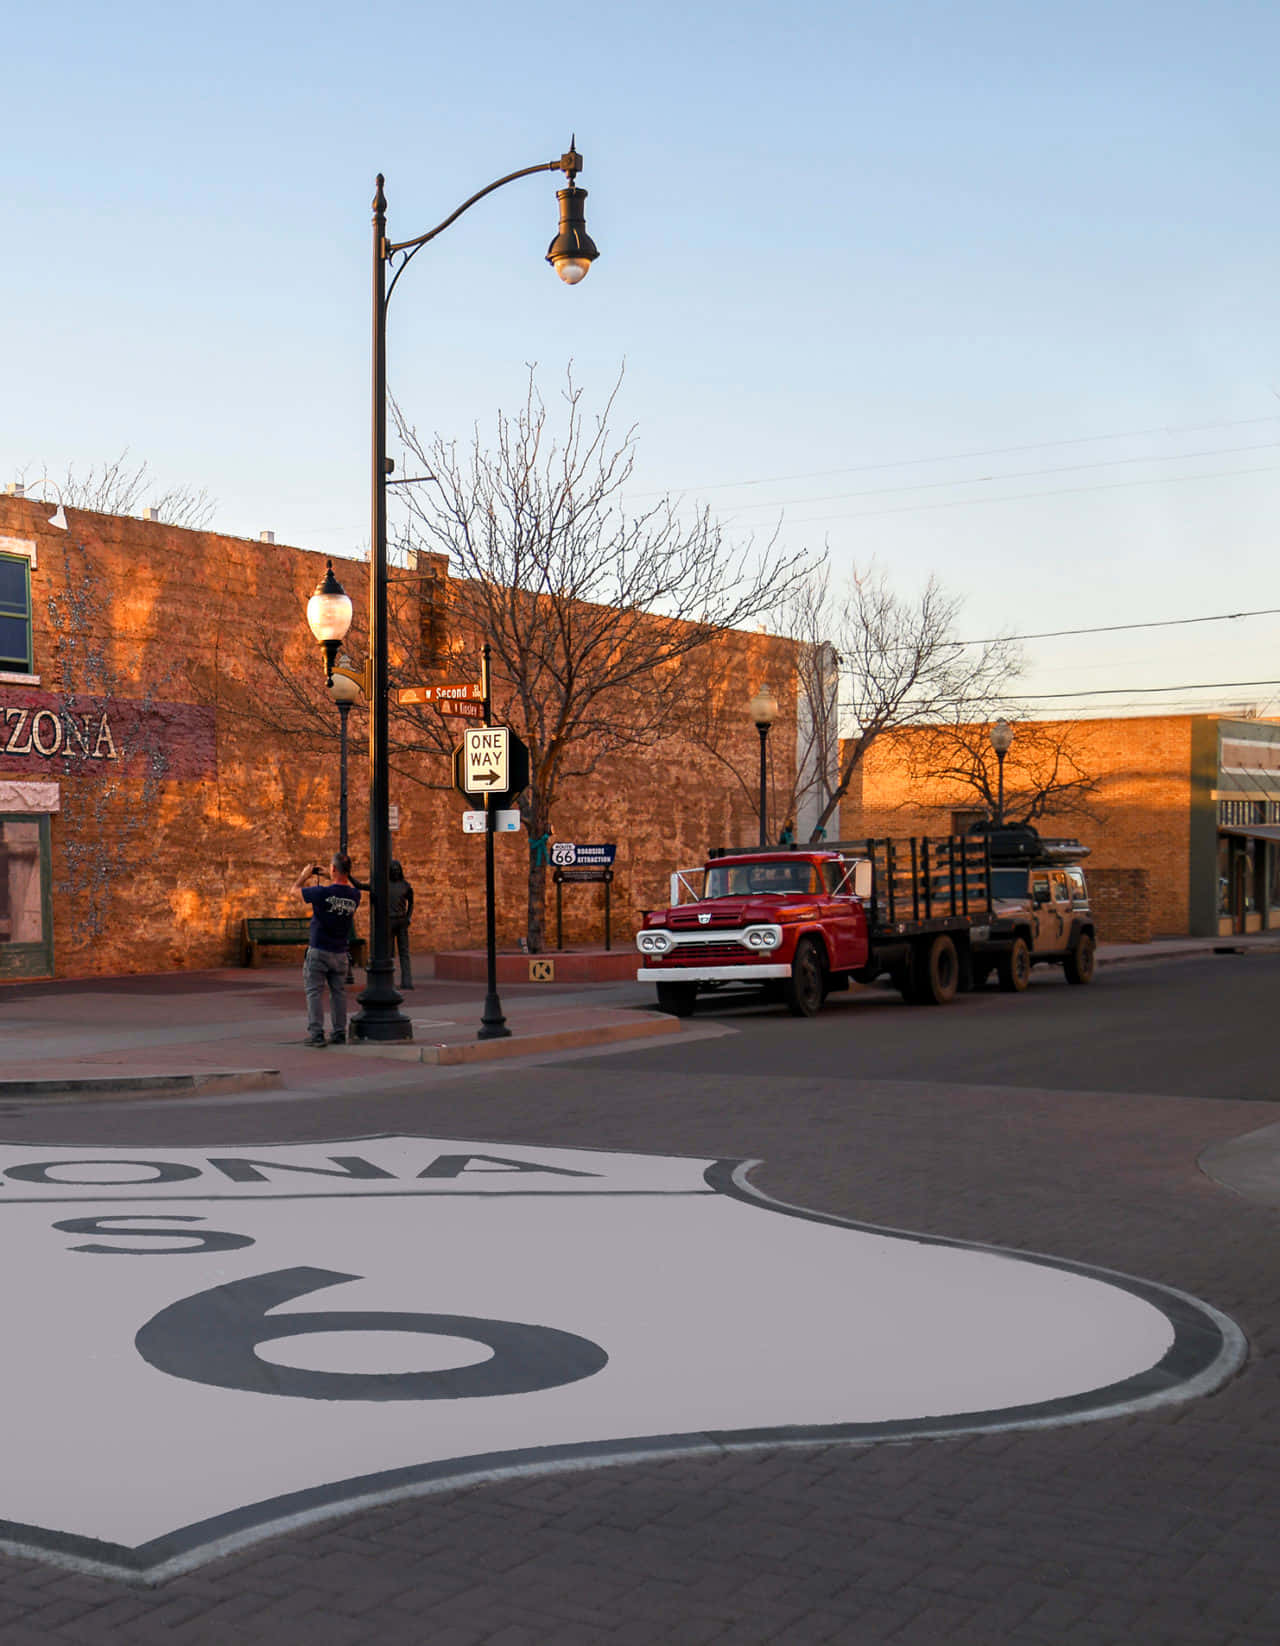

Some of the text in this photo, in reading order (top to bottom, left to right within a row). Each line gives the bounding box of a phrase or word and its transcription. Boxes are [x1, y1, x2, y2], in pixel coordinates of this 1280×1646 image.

[435, 685, 468, 700] Second
[471, 734, 502, 749] ONE
[471, 752, 502, 767] WAY
[556, 851, 573, 864] 66
